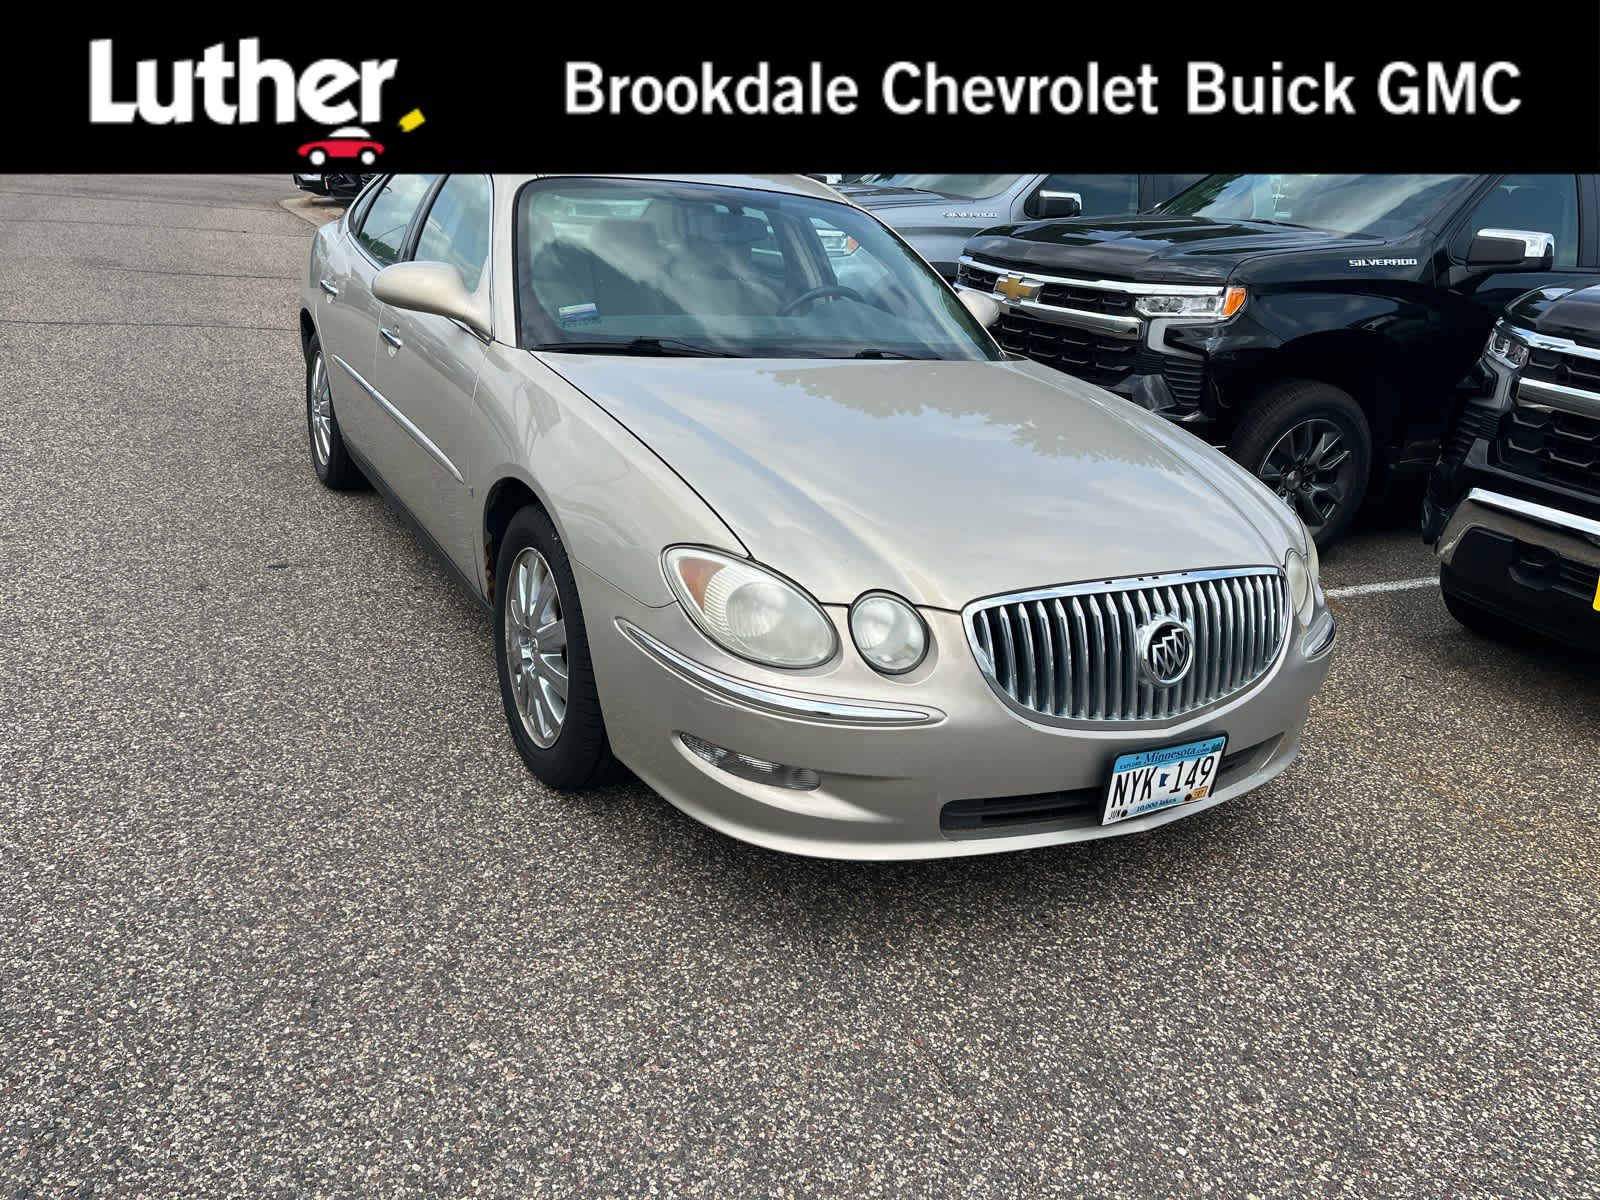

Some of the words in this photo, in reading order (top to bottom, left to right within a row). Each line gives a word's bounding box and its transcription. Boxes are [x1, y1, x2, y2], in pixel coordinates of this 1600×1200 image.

[1348, 258, 1418, 267] SILVERADO
[1111, 766, 1158, 808] NYK
[1169, 755, 1215, 794] 149
